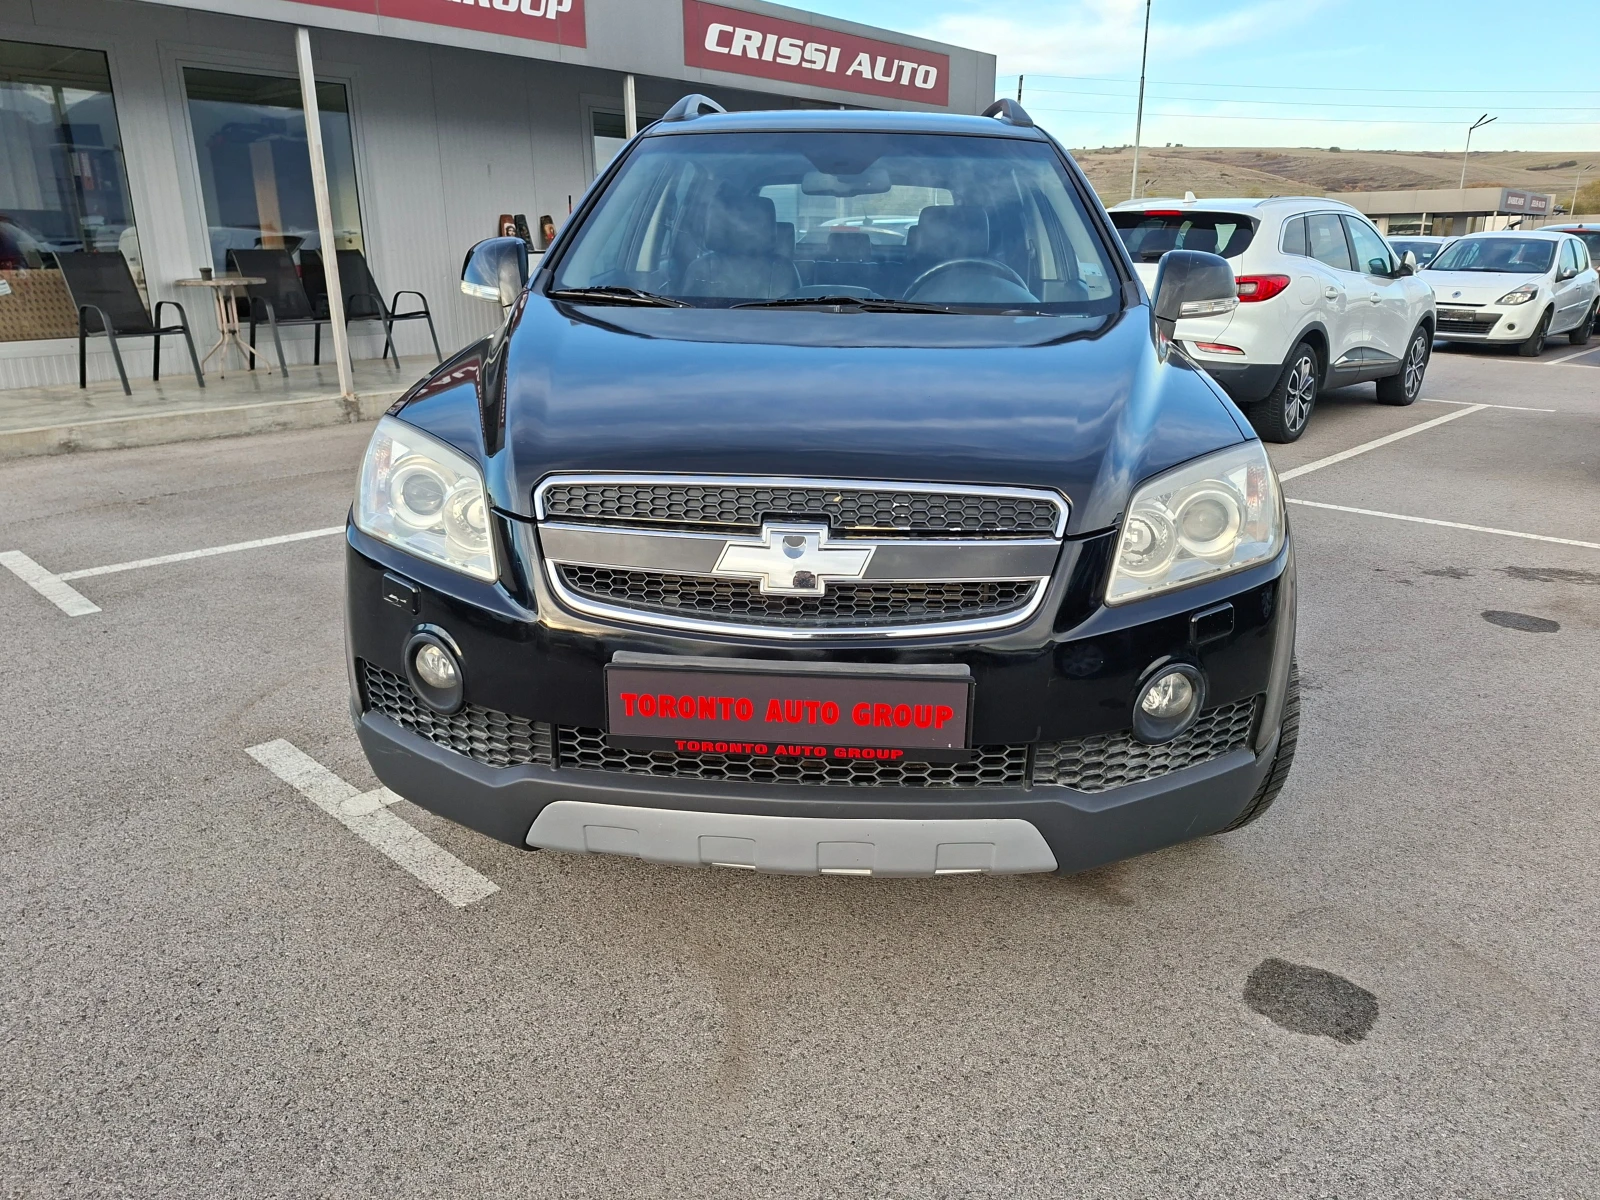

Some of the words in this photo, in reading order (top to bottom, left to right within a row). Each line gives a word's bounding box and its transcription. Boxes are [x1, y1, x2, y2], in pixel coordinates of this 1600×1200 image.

[704, 23, 841, 73] CRISSI
[845, 52, 938, 90] AUTO
[620, 693, 754, 722] TORONTO
[764, 699, 840, 724] AUTO
[852, 702, 954, 729] GROUP
[674, 740, 768, 755] TORONTO
[774, 744, 827, 757] AUTO
[834, 747, 904, 760] GROUP
